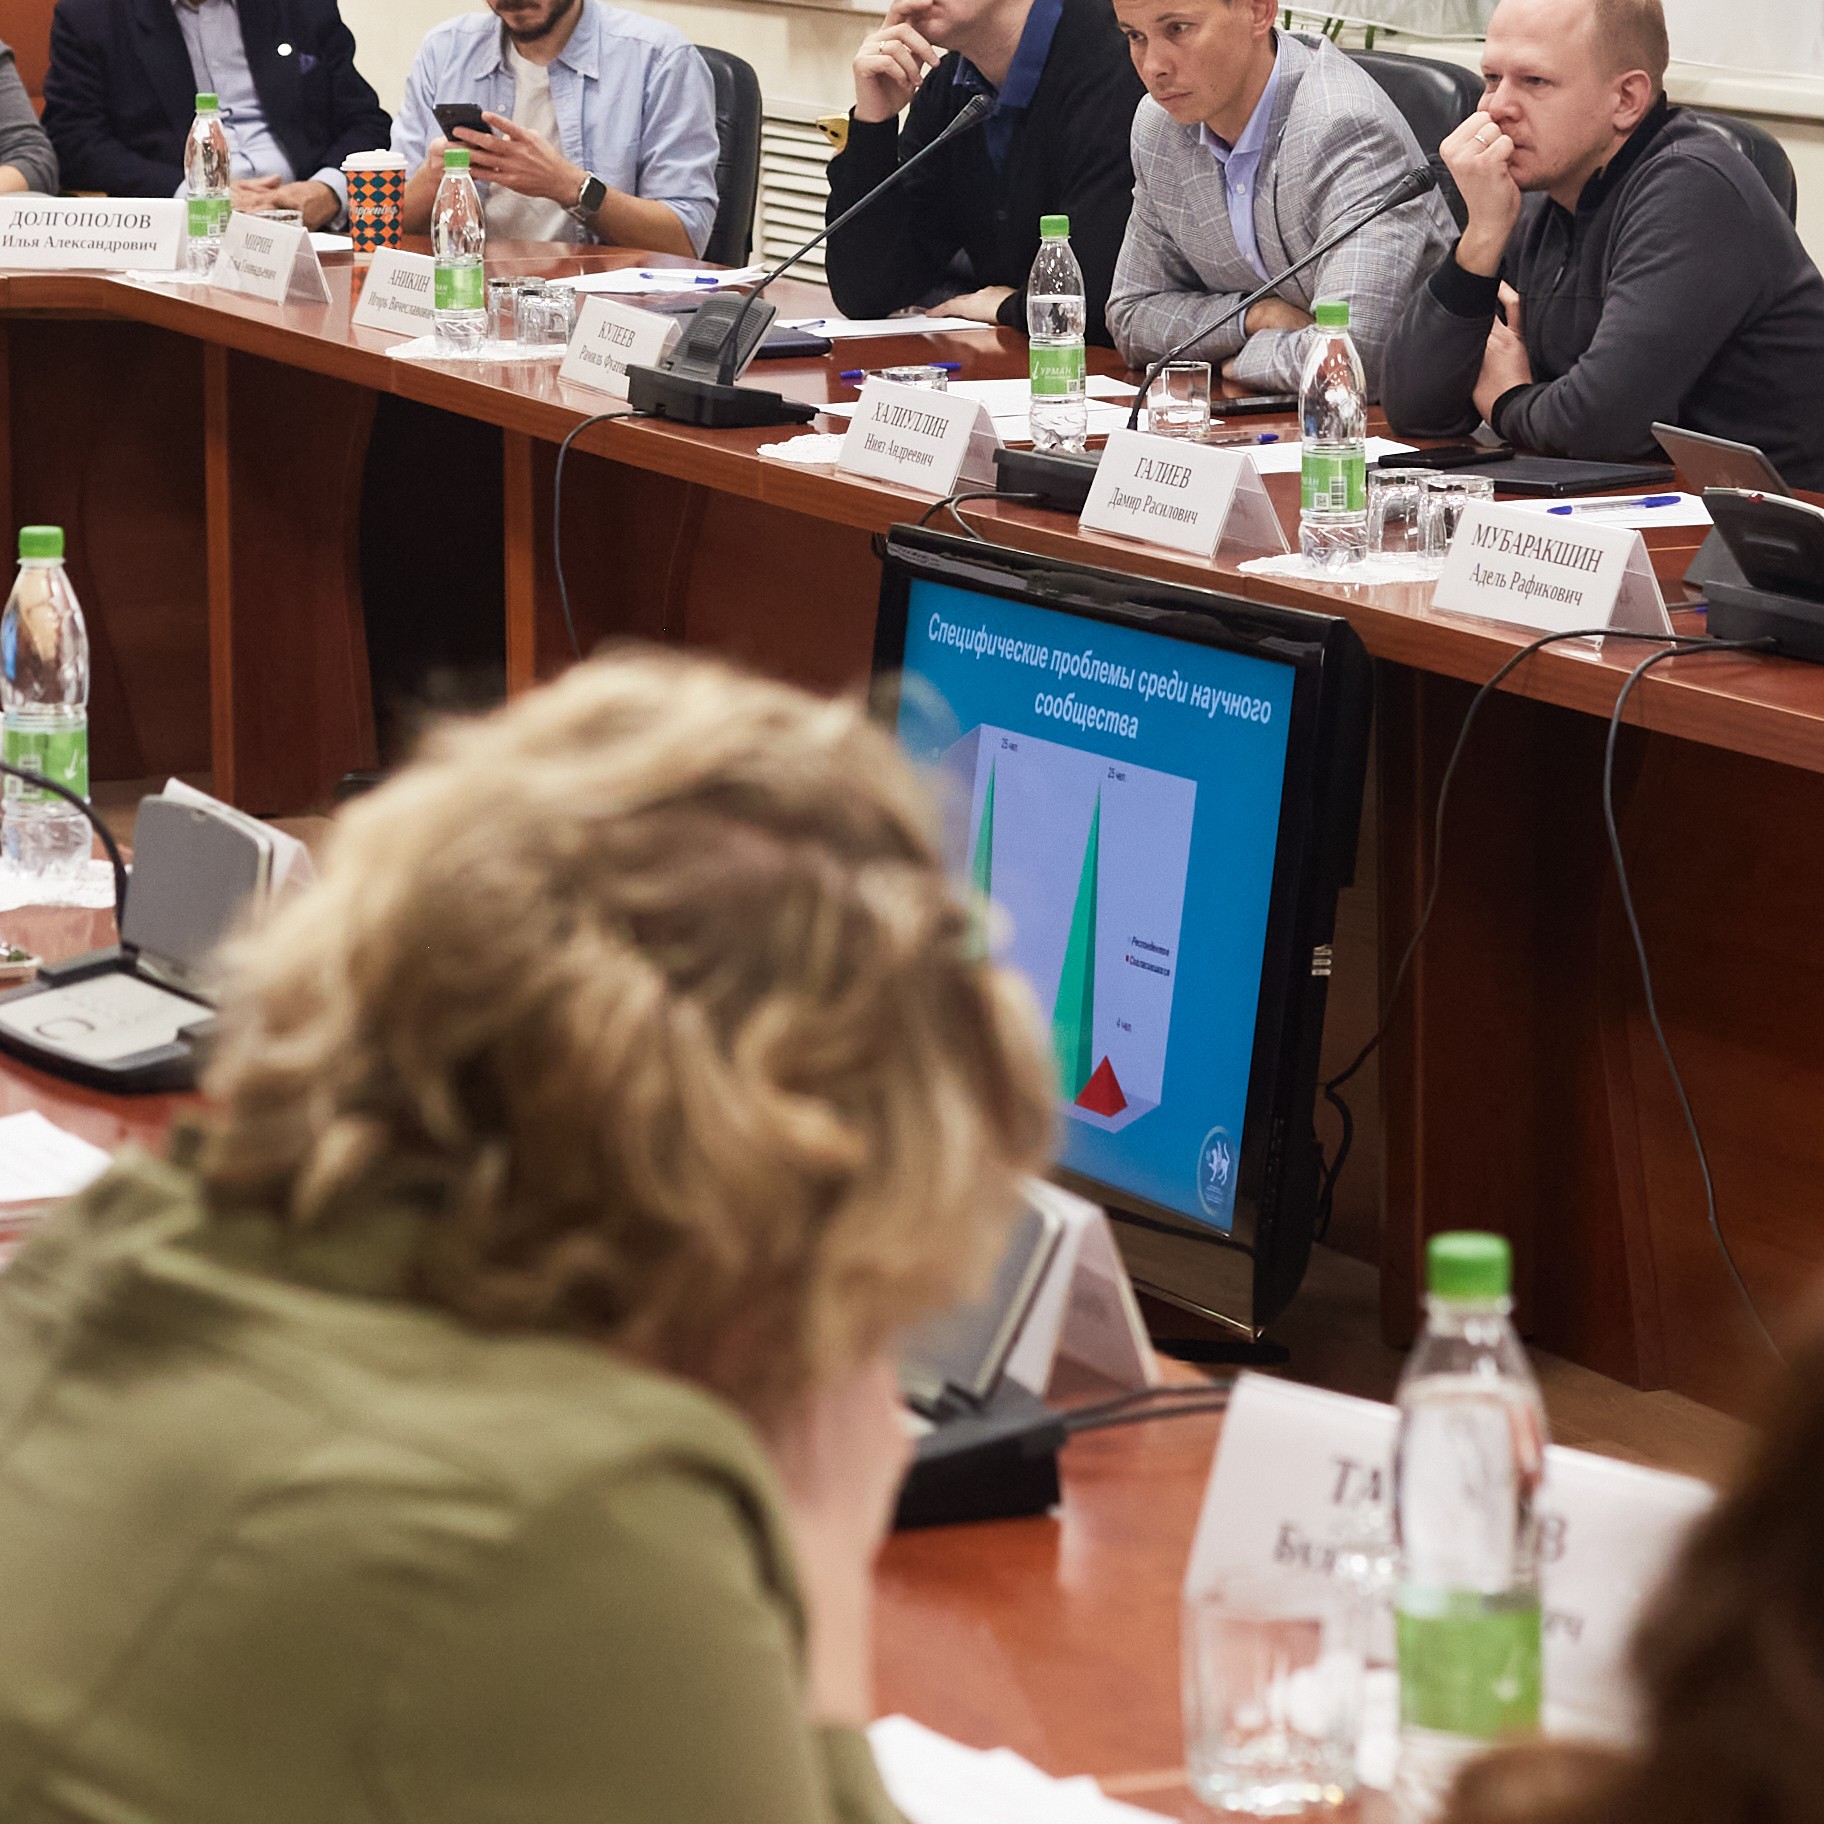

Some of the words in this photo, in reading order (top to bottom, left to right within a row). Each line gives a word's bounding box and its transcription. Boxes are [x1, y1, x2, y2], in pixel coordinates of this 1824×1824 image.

[9, 211, 152, 229] ДОЛГОПОЛОВ
[2, 234, 39, 248] Илья
[43, 236, 158, 253] Александрович
[388, 269, 431, 293] АНИКИН
[368, 291, 388, 311] Игорь
[597, 321, 636, 348] КУЛЕЕВ
[1041, 366, 1072, 376] УРМАН
[871, 401, 950, 439] ХАЛИУЛЛИН
[864, 433, 886, 454] Нияз
[885, 439, 935, 467] Андреевич
[1134, 457, 1193, 489] ГАЛИЕВ
[1107, 487, 1142, 515] Дамир
[1142, 495, 1199, 525] Расилович
[1471, 523, 1605, 574] МУБАРАКШИН
[1470, 563, 1507, 588] Адель
[1509, 571, 1584, 607] Рафикович
[928, 612, 1049, 669] Специфические
[1050, 650, 1135, 690] проблемы
[1137, 670, 1190, 704] среди
[1190, 683, 1272, 725] научного
[1034, 691, 1140, 740] сообщества
